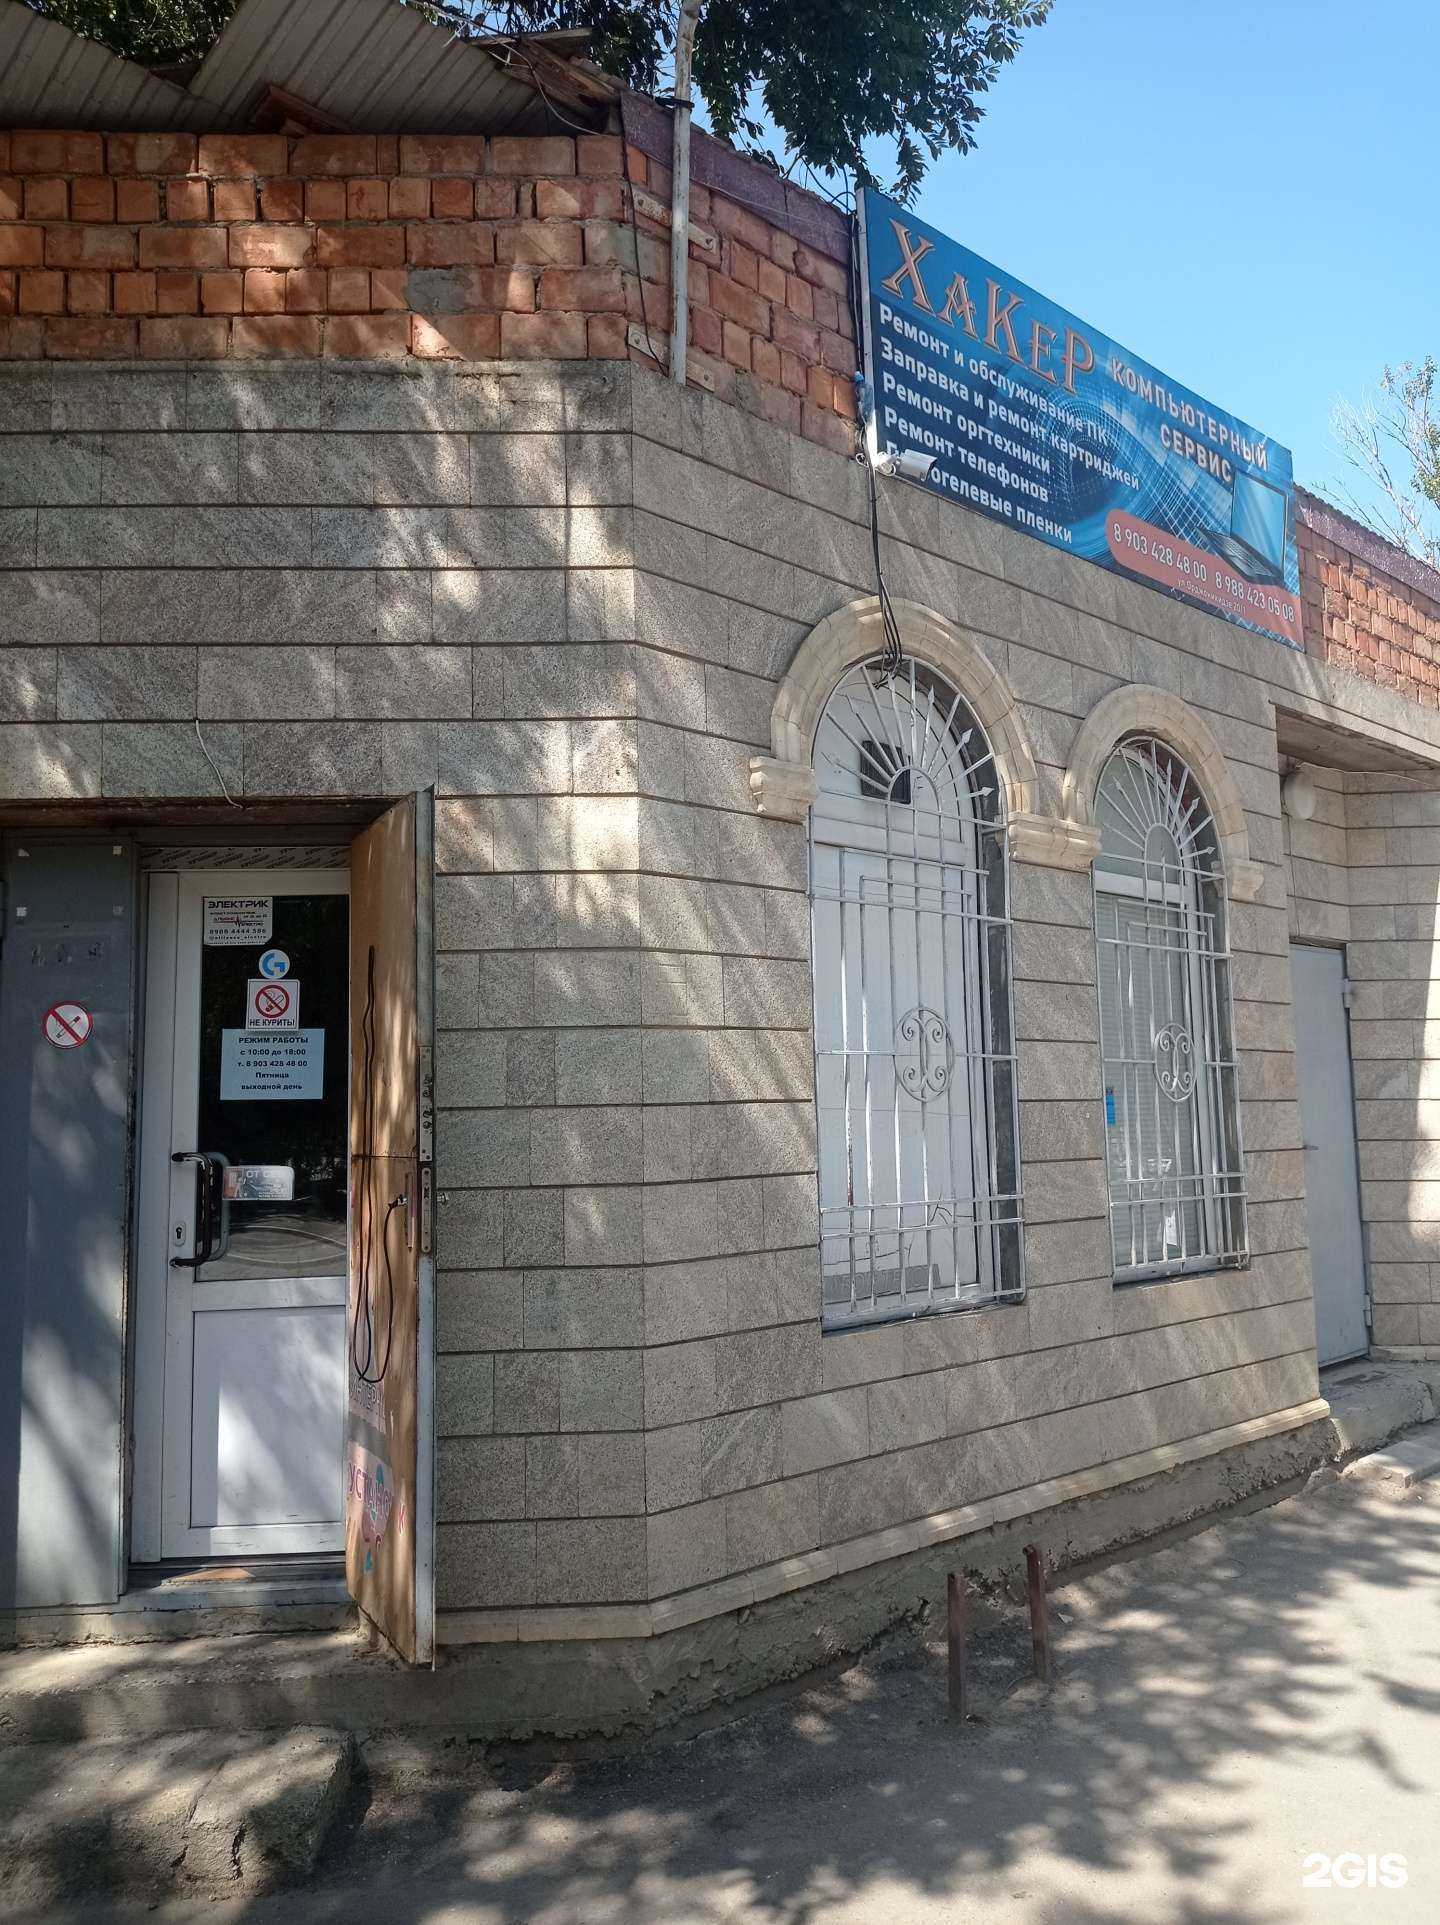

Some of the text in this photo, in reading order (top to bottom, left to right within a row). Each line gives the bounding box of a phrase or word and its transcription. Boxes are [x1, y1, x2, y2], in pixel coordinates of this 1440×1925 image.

[881, 218, 1096, 396] ХАКЕР
[879, 302, 1109, 447] Ремонт и обслуживание ПК
[880, 335, 1140, 491] Заправка и ремонт картриджей
[882, 370, 1051, 474] Ремонт оргтехники
[1111, 357, 1268, 472] КОМПЬЮТЕРНЫЙ
[884, 405, 1049, 503] Ремонт телефонов
[1160, 423, 1232, 483] СЕРВИС
[1016, 505, 1073, 545] пленки
[1113, 523, 1208, 582] 8 903 428 48 00
[1215, 571, 1296, 623] 8 988 423 05 08
[208, 900, 269, 909] ЭЛЕКТРИК
[248, 1048, 270, 1056] 10:00
[271, 1049, 282, 1057] до
[249, 1018, 261, 1027] НЕ
